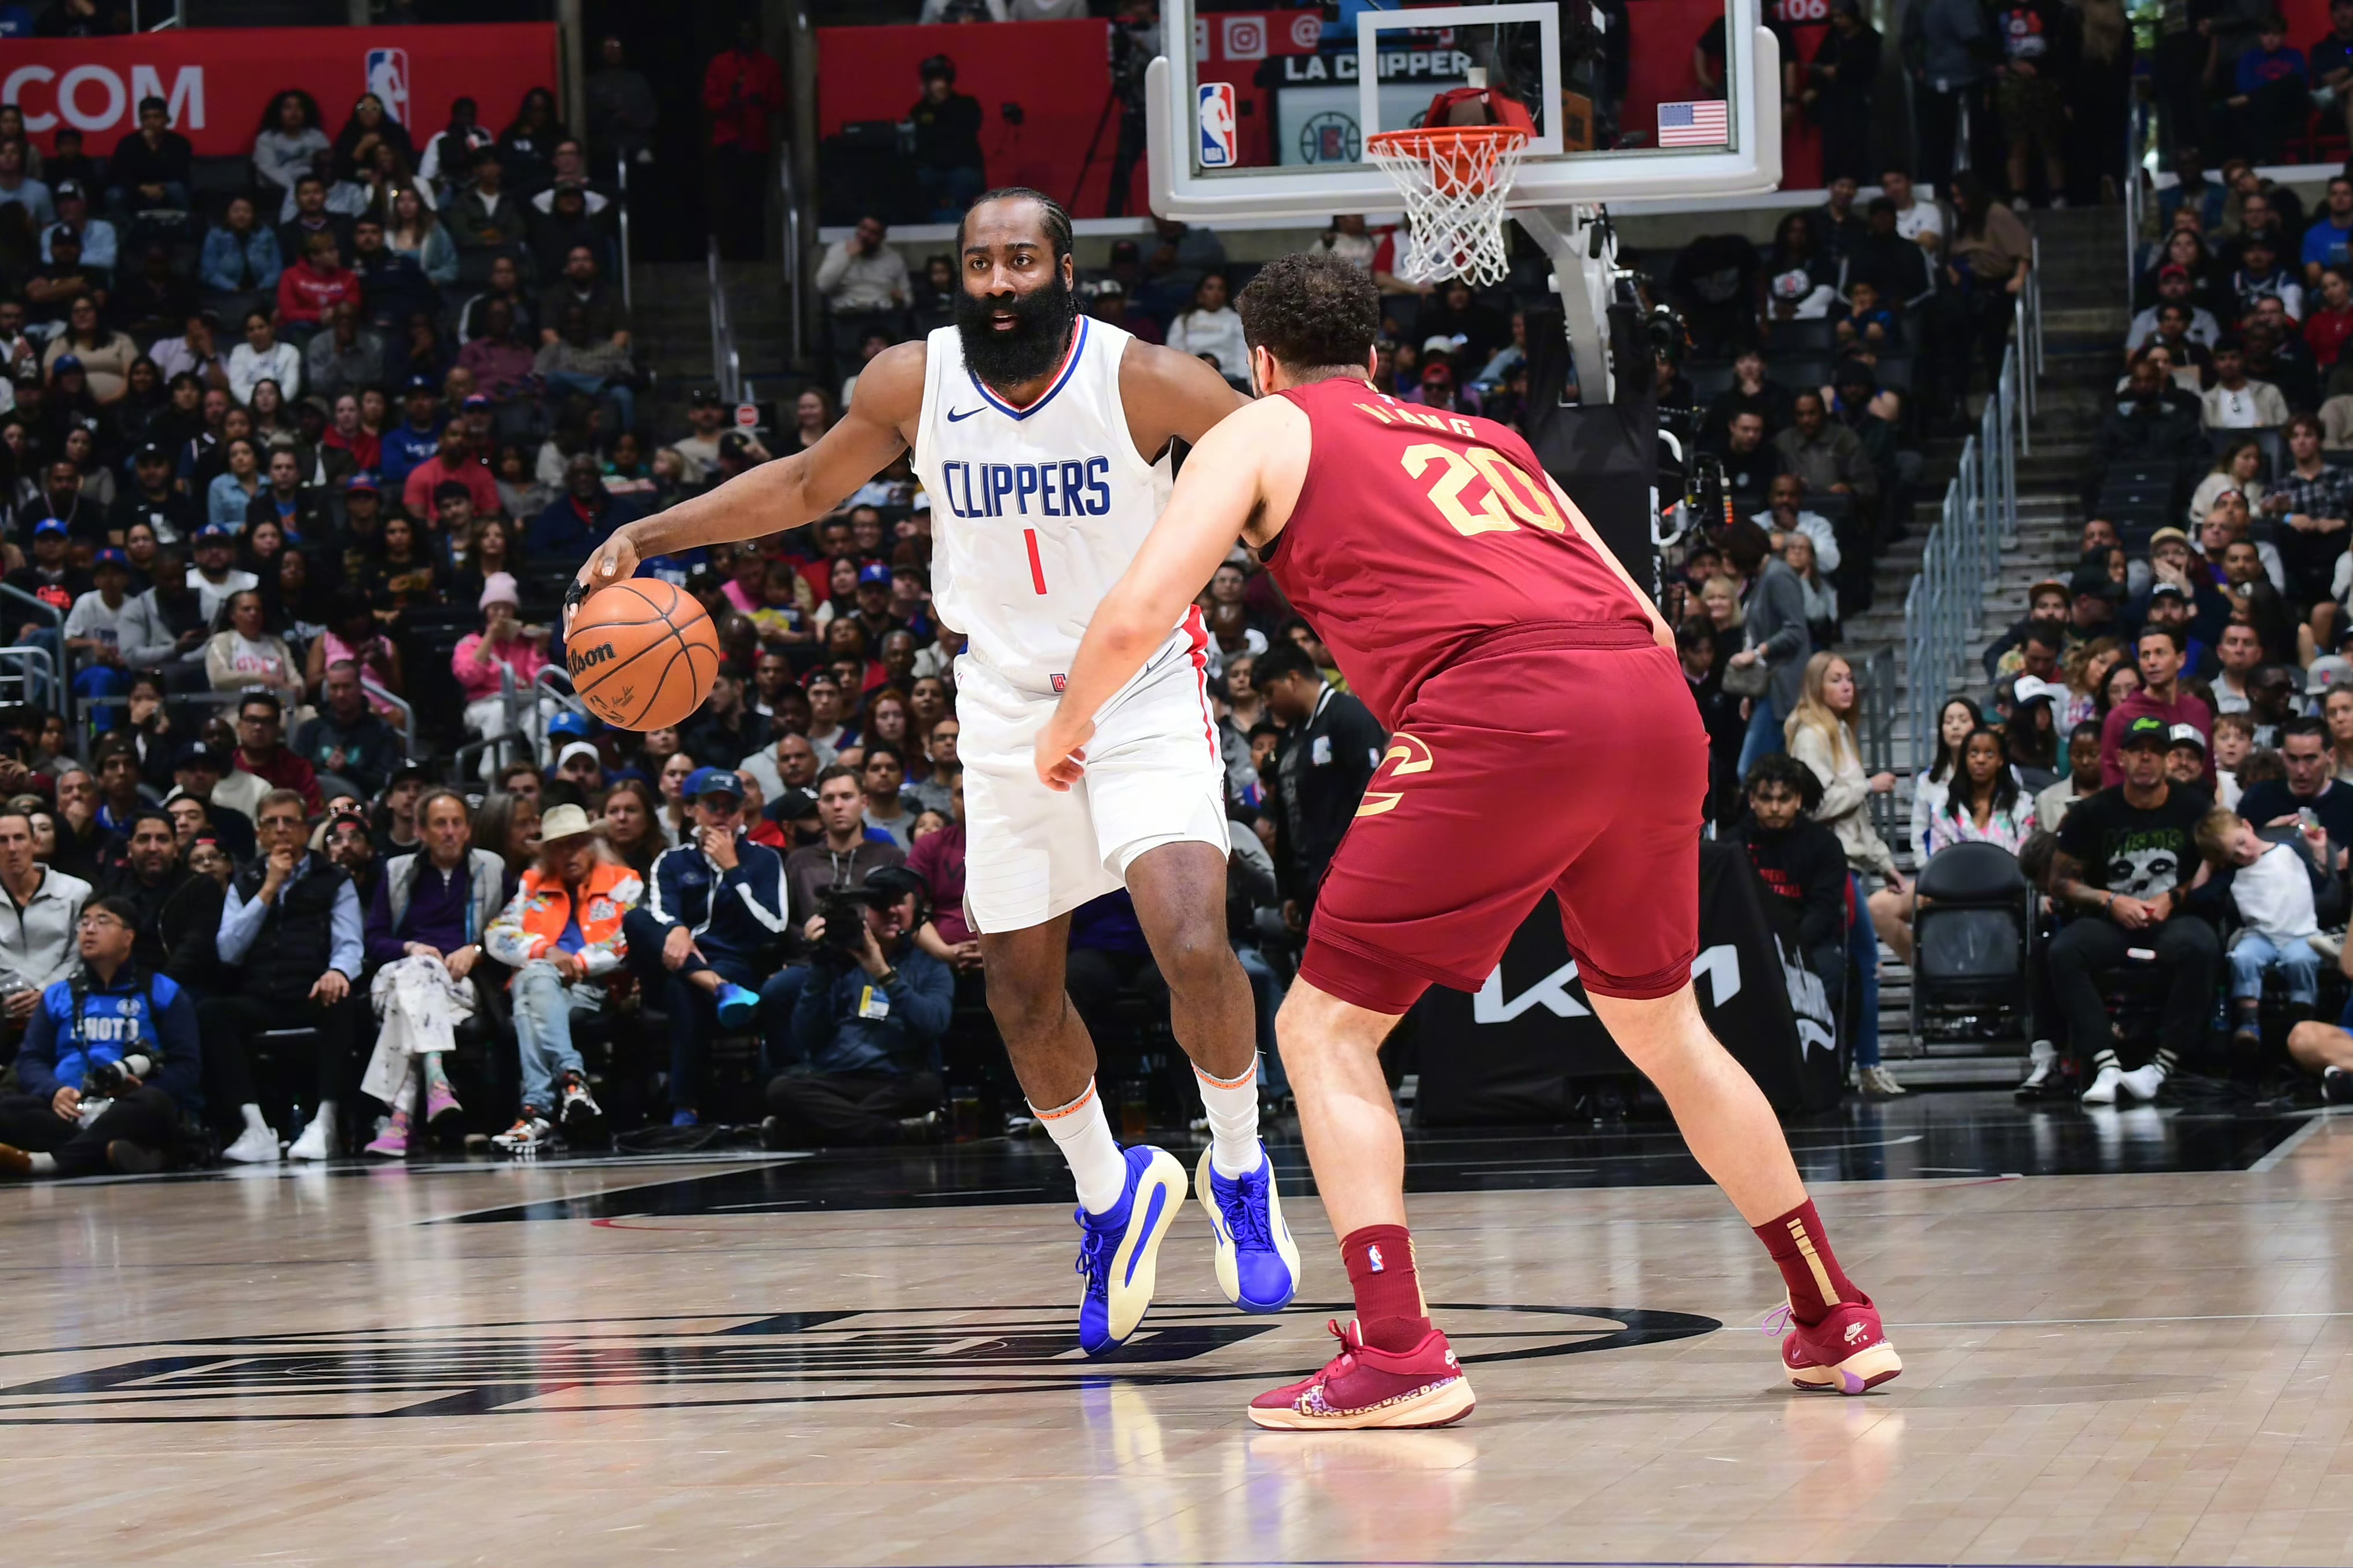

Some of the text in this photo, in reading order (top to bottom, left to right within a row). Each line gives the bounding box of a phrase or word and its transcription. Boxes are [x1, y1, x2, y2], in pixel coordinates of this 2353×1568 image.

[1285, 50, 1472, 81] LA CIPPER
[941, 456, 1110, 519] CLIPPERS
[1401, 443, 1566, 537] 20
[1023, 528, 1048, 595] 1
[567, 641, 617, 680] ilson
[70, 1016, 140, 1042] HOTO
[1846, 1321, 1862, 1335] NIKE
[1850, 1334, 1869, 1346] AIR
